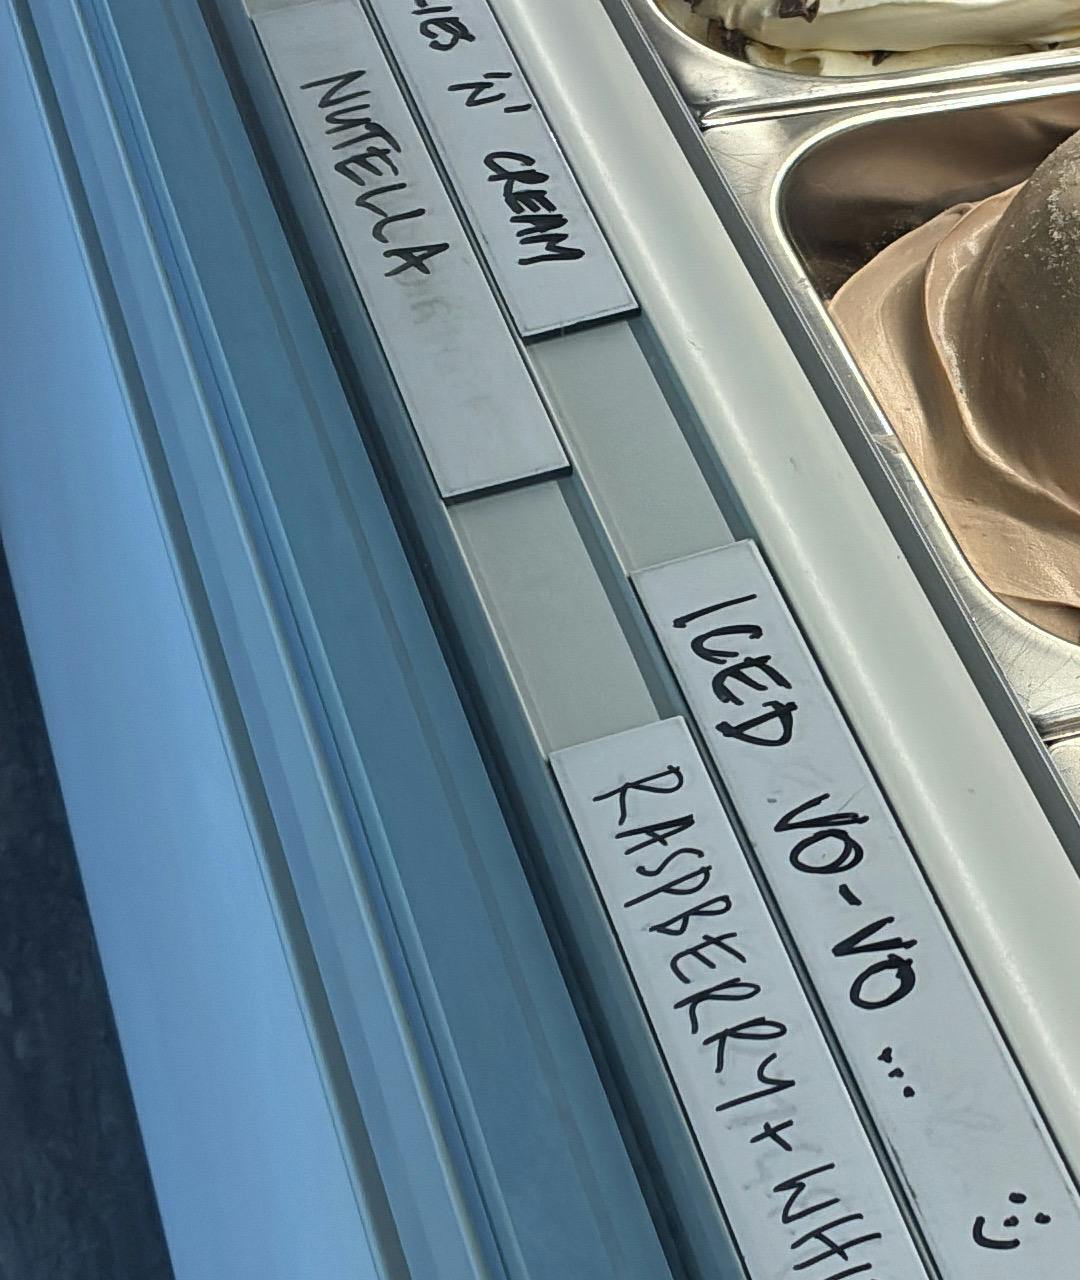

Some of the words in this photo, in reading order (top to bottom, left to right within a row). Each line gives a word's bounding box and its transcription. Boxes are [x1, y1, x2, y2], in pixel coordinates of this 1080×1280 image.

[299, 69, 450, 278] NUTELLA
[483, 151, 586, 266] CREAM
[672, 593, 797, 750] ICED
[594, 763, 797, 1118] RASPBERRY
